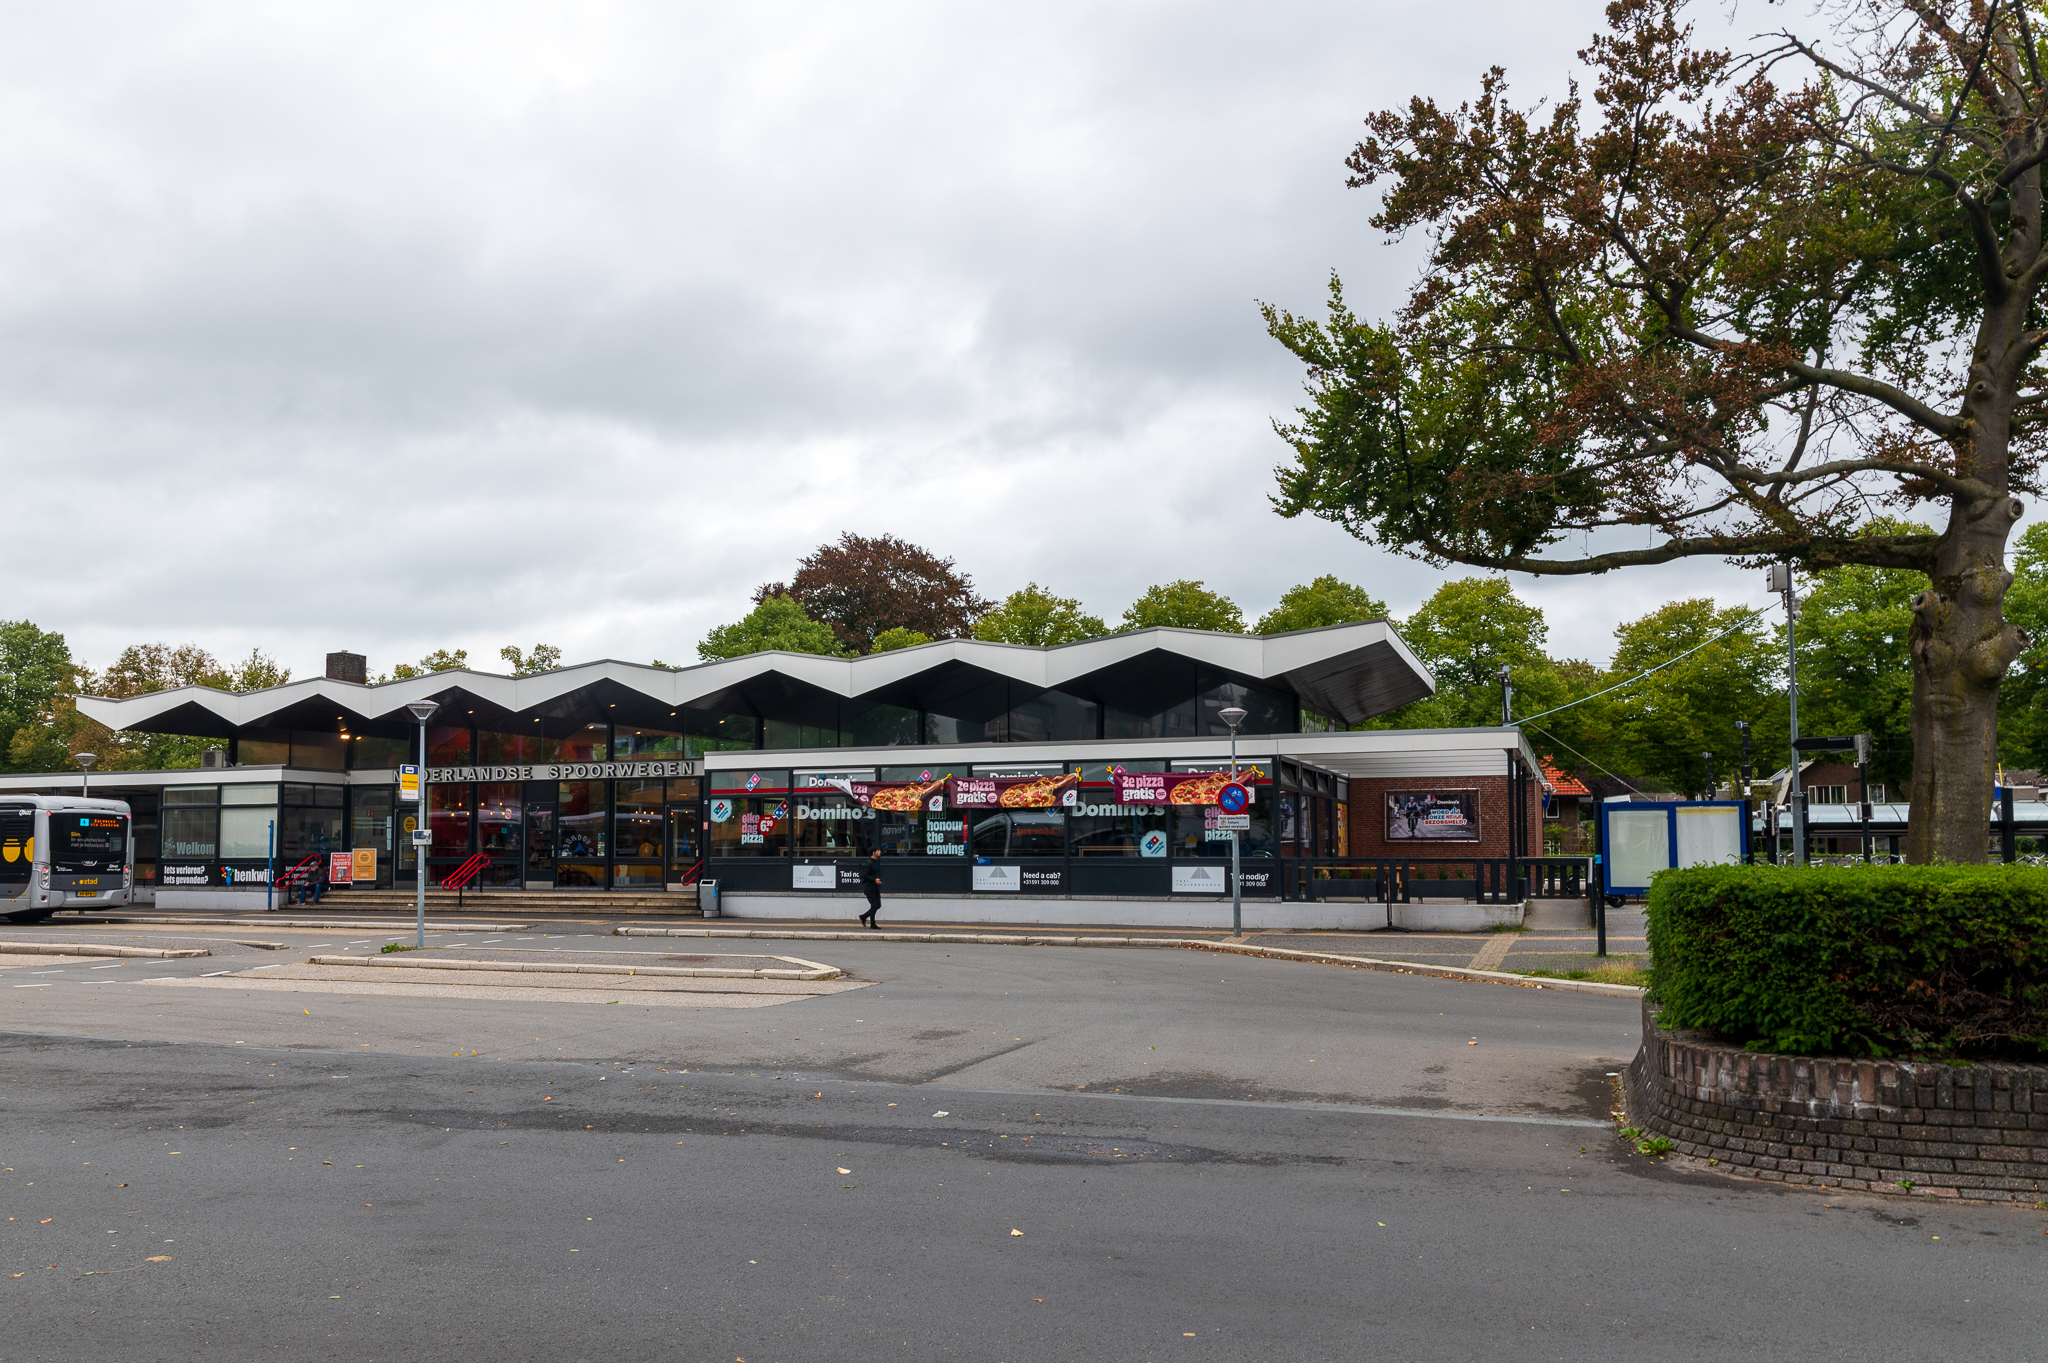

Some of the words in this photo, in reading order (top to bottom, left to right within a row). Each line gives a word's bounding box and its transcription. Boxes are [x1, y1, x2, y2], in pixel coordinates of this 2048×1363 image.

[393, 766, 533, 782] NDERLANDSE
[548, 762, 694, 778] SPOORWEGEN
[957, 780, 968, 790] 2e
[969, 780, 996, 792] pizza
[1122, 776, 1135, 788] 2e
[1136, 775, 1164, 790] pizza
[852, 785, 868, 794] zza
[1122, 788, 1155, 801] gratis
[956, 792, 986, 804] gratis
[798, 804, 876, 820] Domino's
[1072, 802, 1165, 816] Domino's
[742, 813, 760, 824] elke
[1205, 818, 1218, 829] da
[742, 824, 758, 835] dag
[926, 820, 964, 831] honour
[742, 833, 764, 844] pizza
[926, 832, 944, 842] the
[1205, 829, 1233, 842] pizza
[176, 842, 215, 855] Welkom
[926, 843, 964, 855] craving
[164, 866, 175, 874] Iets
[176, 866, 205, 874] verloren?
[164, 875, 175, 884] Iets
[176, 875, 209, 885] gevonden?
[1246, 873, 1269, 881] nodig?
